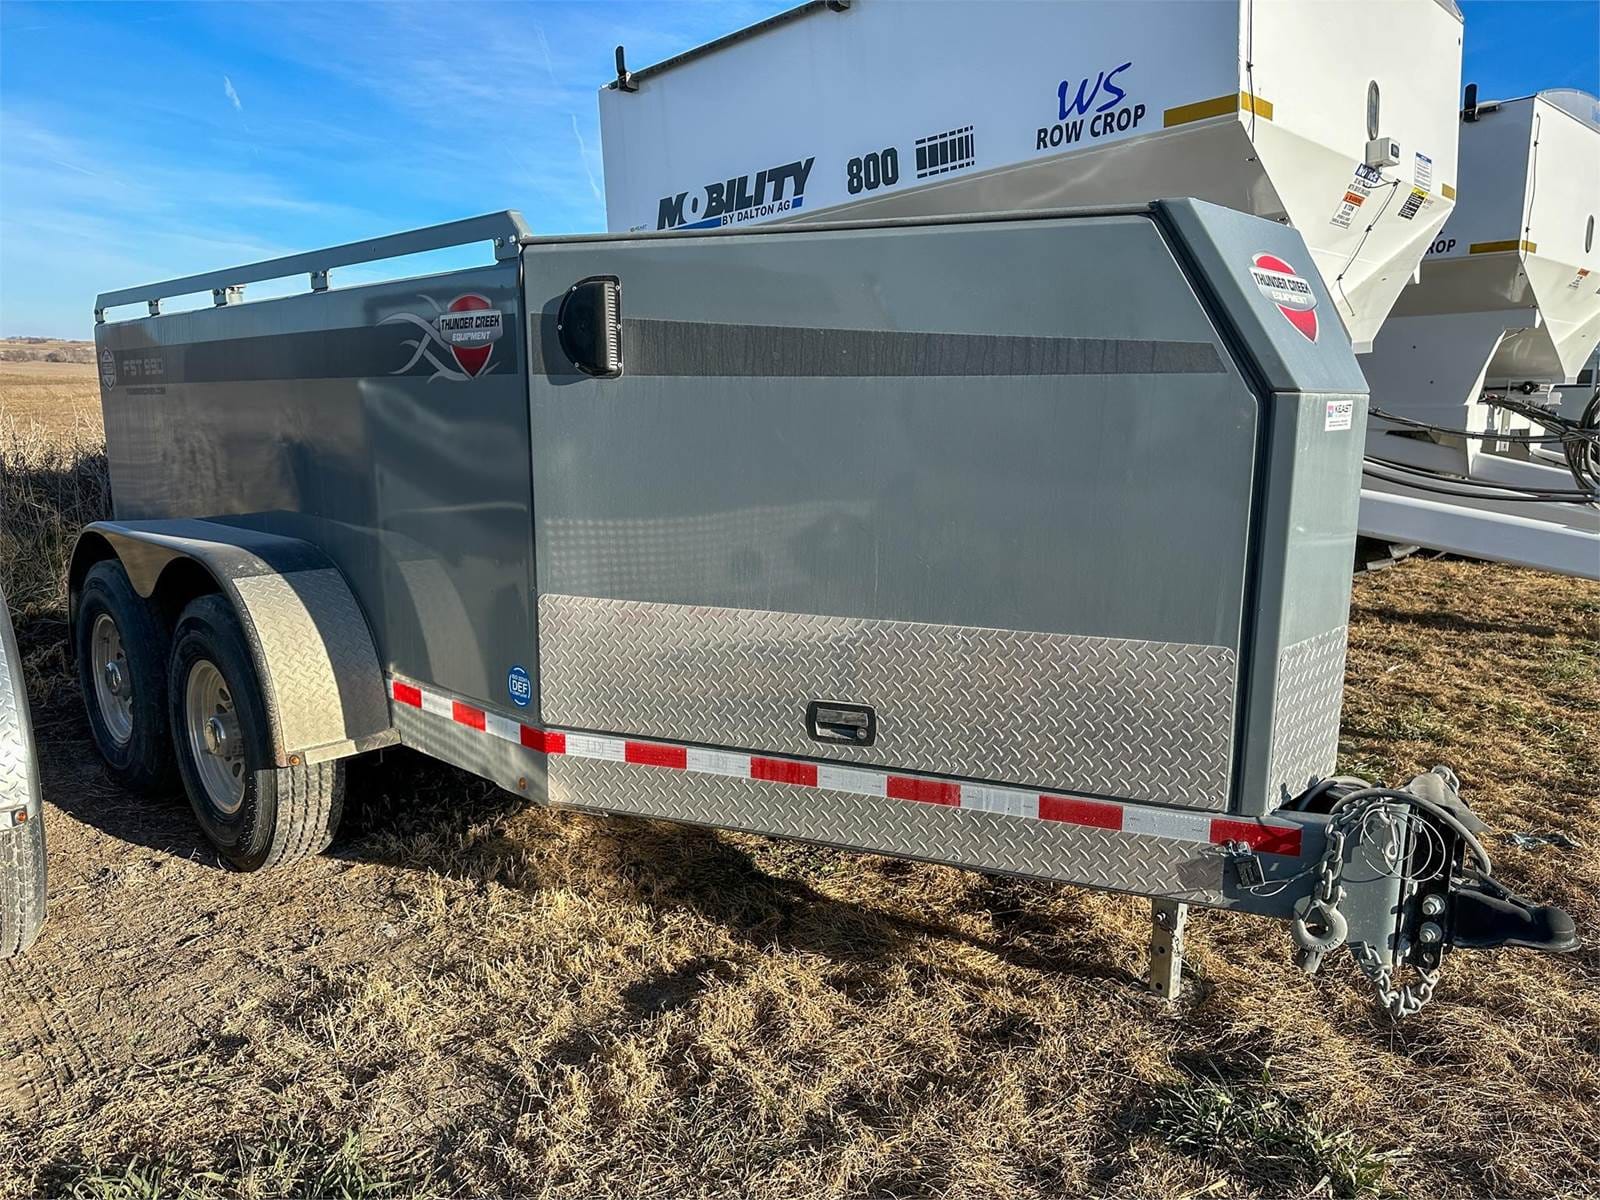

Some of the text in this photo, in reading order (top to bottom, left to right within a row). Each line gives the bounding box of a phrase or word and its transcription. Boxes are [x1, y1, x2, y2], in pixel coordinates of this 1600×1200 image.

[1057, 61, 1132, 121] WS
[1036, 103, 1146, 150] ROW CROP
[847, 147, 899, 195] 800
[656, 156, 816, 231] MOBILITY
[722, 199, 791, 226] BY DALTON AG
[1425, 238, 1457, 255] ROP
[1253, 271, 1312, 295] THUNDER CREEK
[441, 314, 500, 331] THUNDER CREEK
[511, 679, 528, 694] DEF
